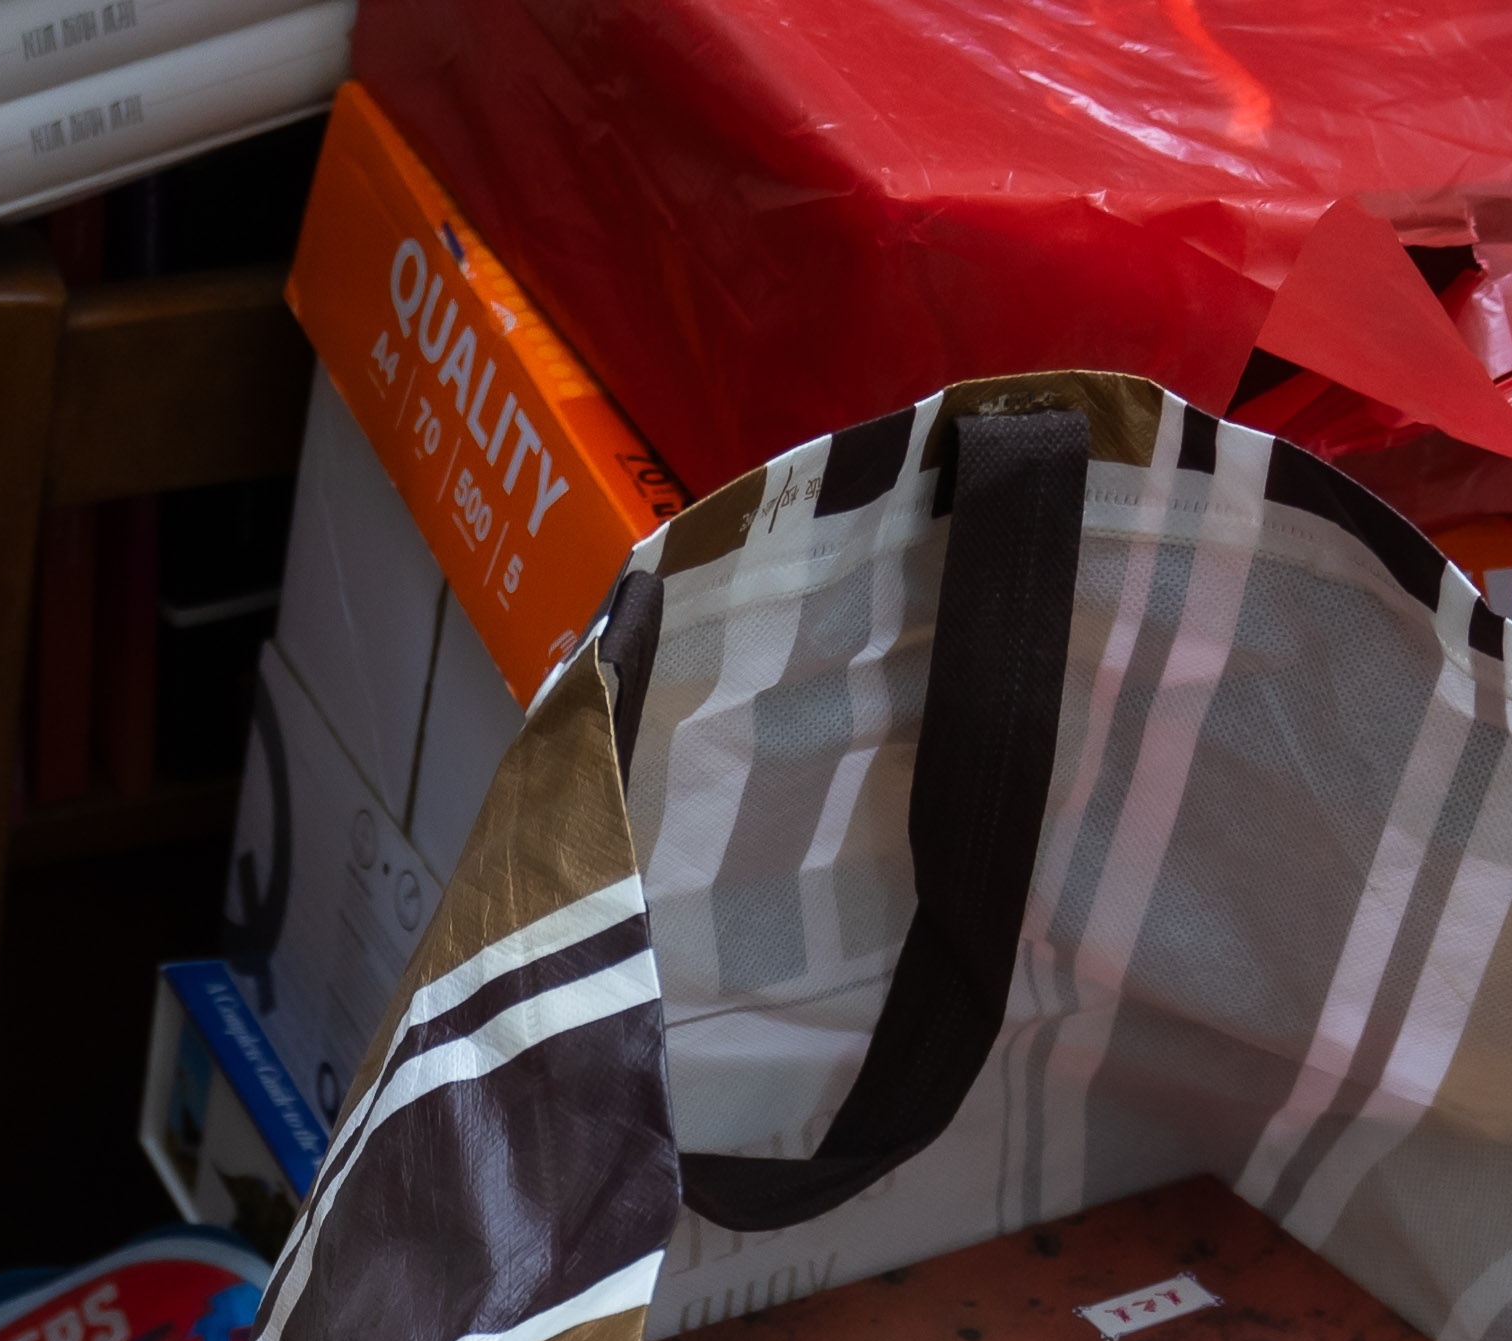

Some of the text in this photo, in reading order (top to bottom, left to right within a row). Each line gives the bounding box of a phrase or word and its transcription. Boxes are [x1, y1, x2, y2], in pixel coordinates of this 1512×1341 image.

[369, 331, 527, 595] A4 70 500 5
[388, 236, 572, 538] QUALITY
